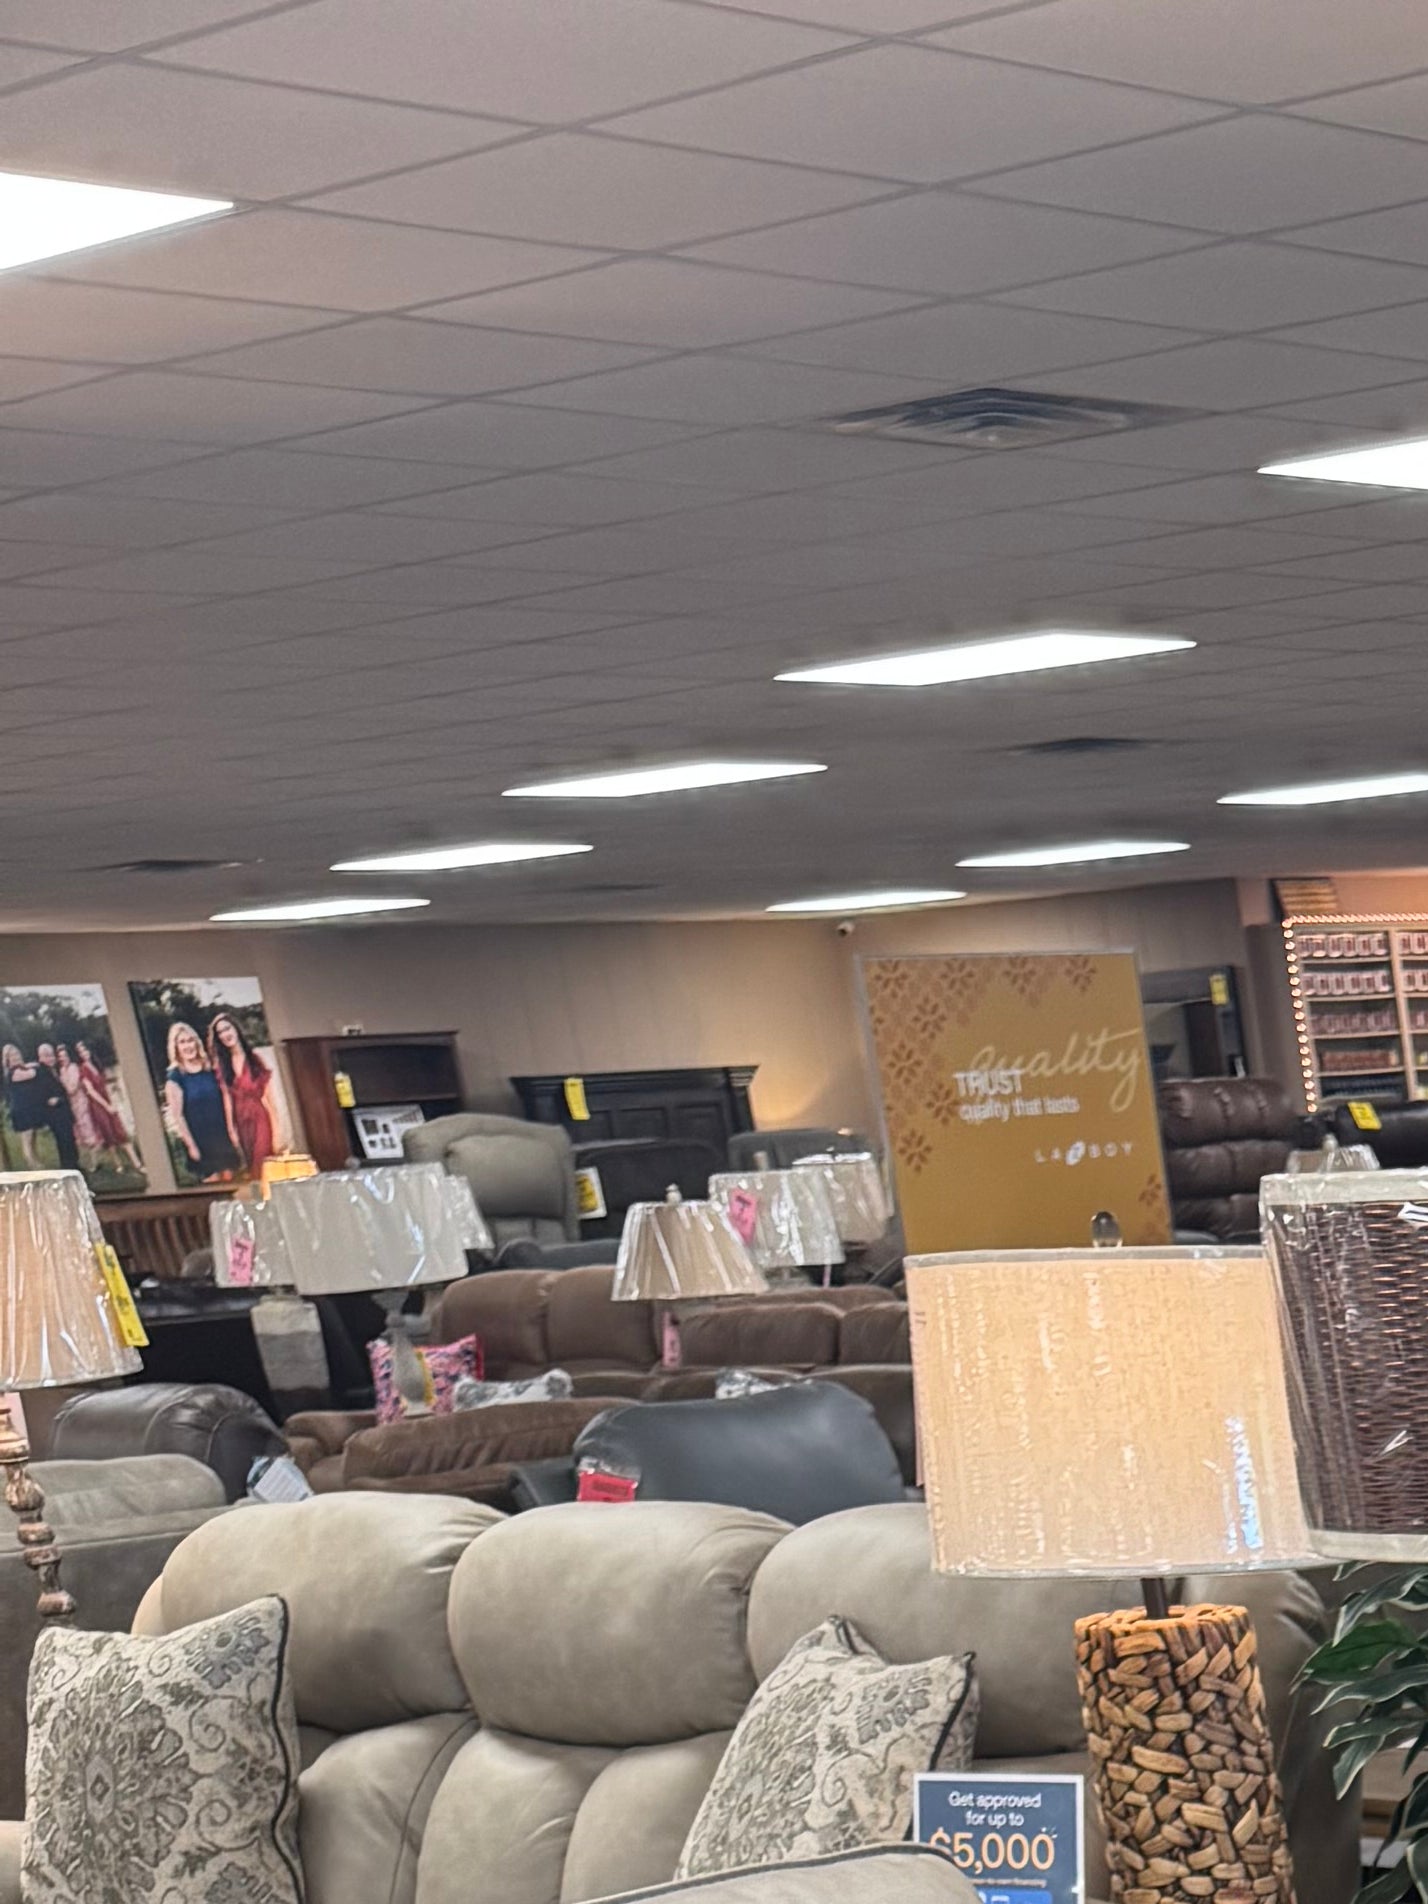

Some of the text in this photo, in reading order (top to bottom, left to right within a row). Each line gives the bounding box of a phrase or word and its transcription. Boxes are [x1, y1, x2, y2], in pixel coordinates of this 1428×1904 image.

[952, 1067, 1024, 1097] TRUST
[959, 1096, 1081, 1123] quality that lasts
[948, 1790, 1042, 1811] Get approved
[965, 1810, 1024, 1829] for up to
